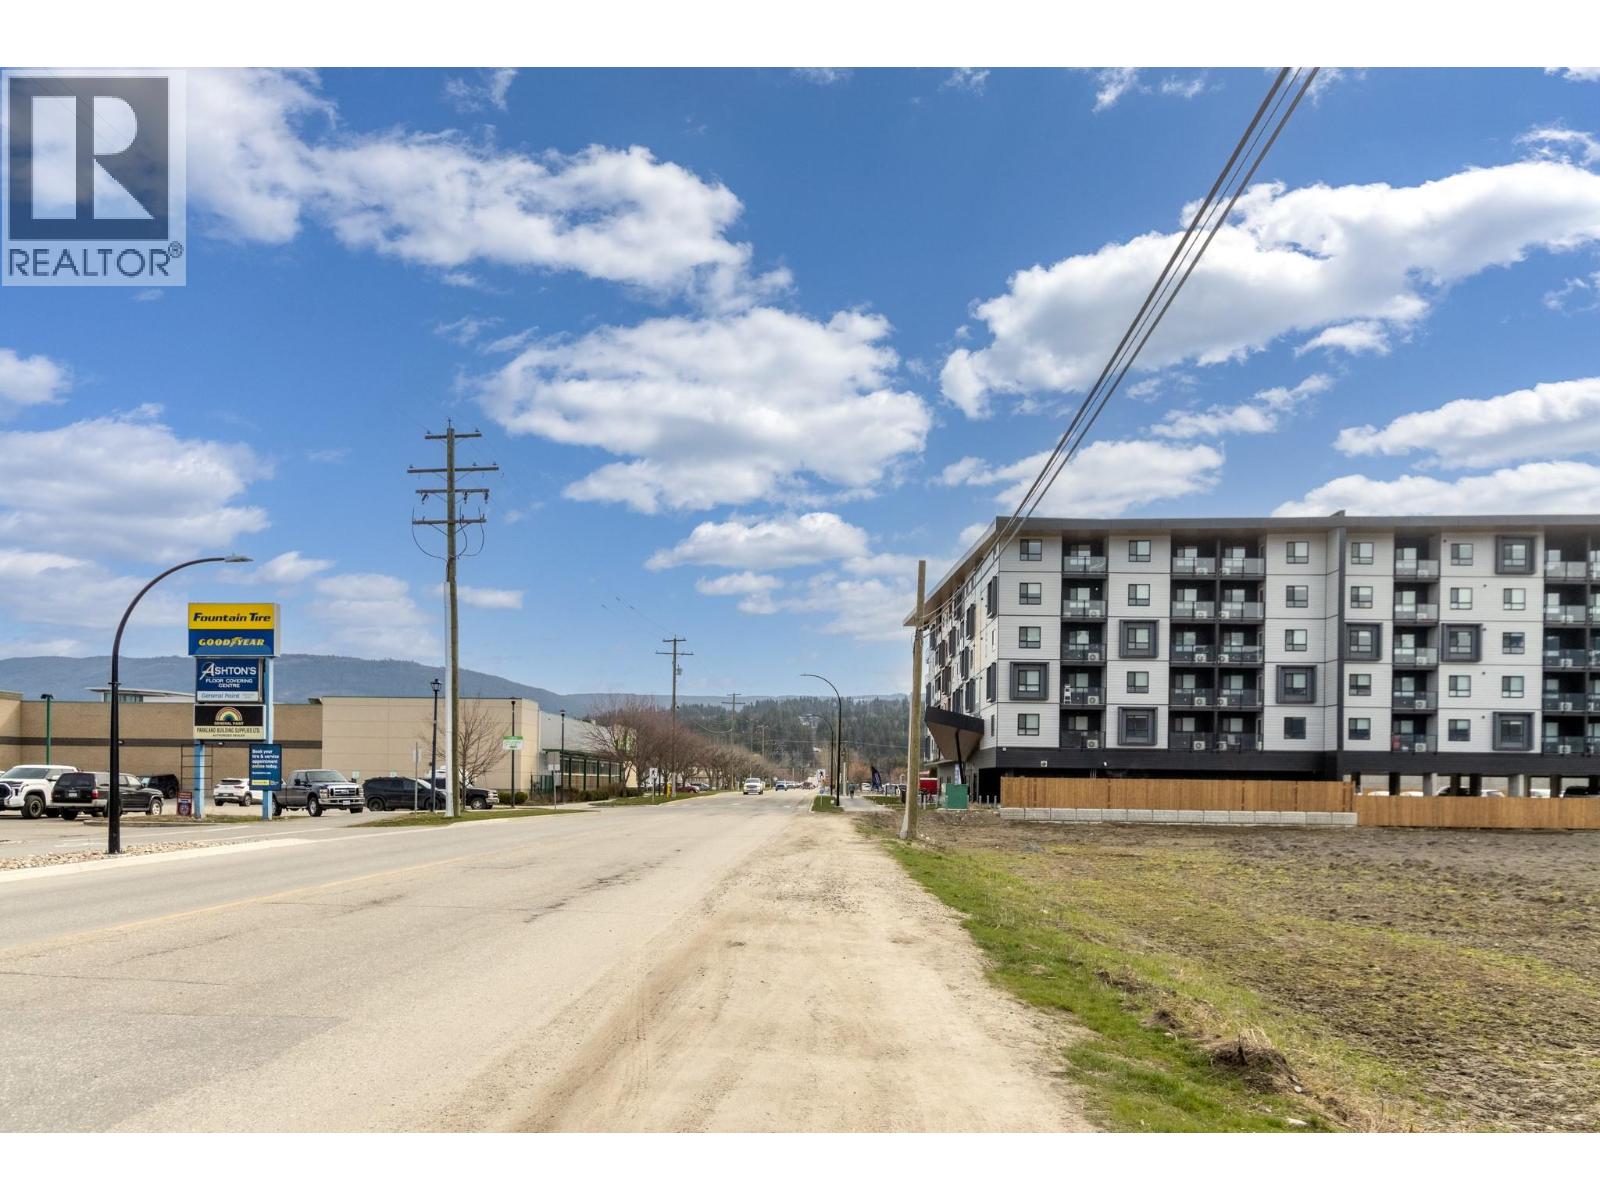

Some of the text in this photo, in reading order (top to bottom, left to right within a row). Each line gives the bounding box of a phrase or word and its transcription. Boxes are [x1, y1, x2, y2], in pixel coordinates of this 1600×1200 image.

[193, 612, 271, 622] Fountain Tire
[198, 637, 264, 647] GOODYEAR
[199, 662, 257, 680] ASHTON'S
